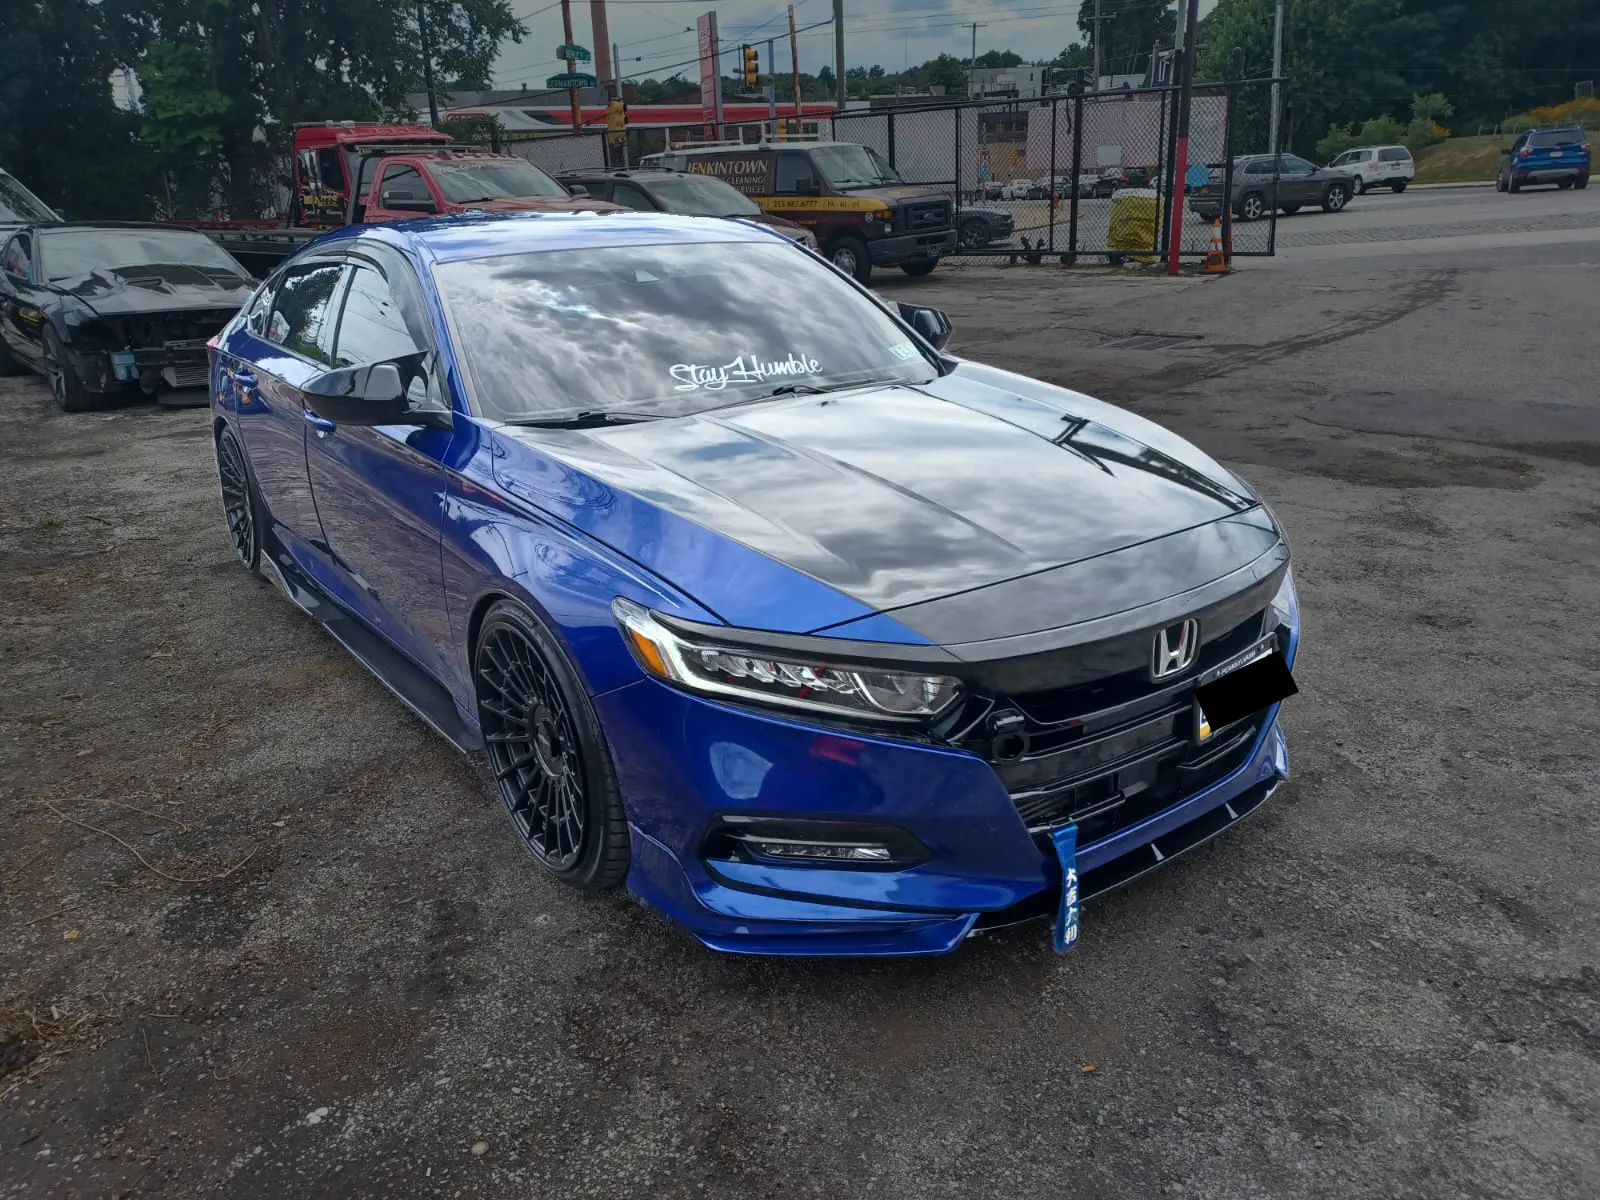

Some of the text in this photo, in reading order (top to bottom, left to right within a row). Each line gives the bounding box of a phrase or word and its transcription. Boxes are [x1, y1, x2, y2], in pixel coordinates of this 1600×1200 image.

[688, 160, 768, 175] JENKINTOWN
[669, 353, 823, 391] Stay Humble
